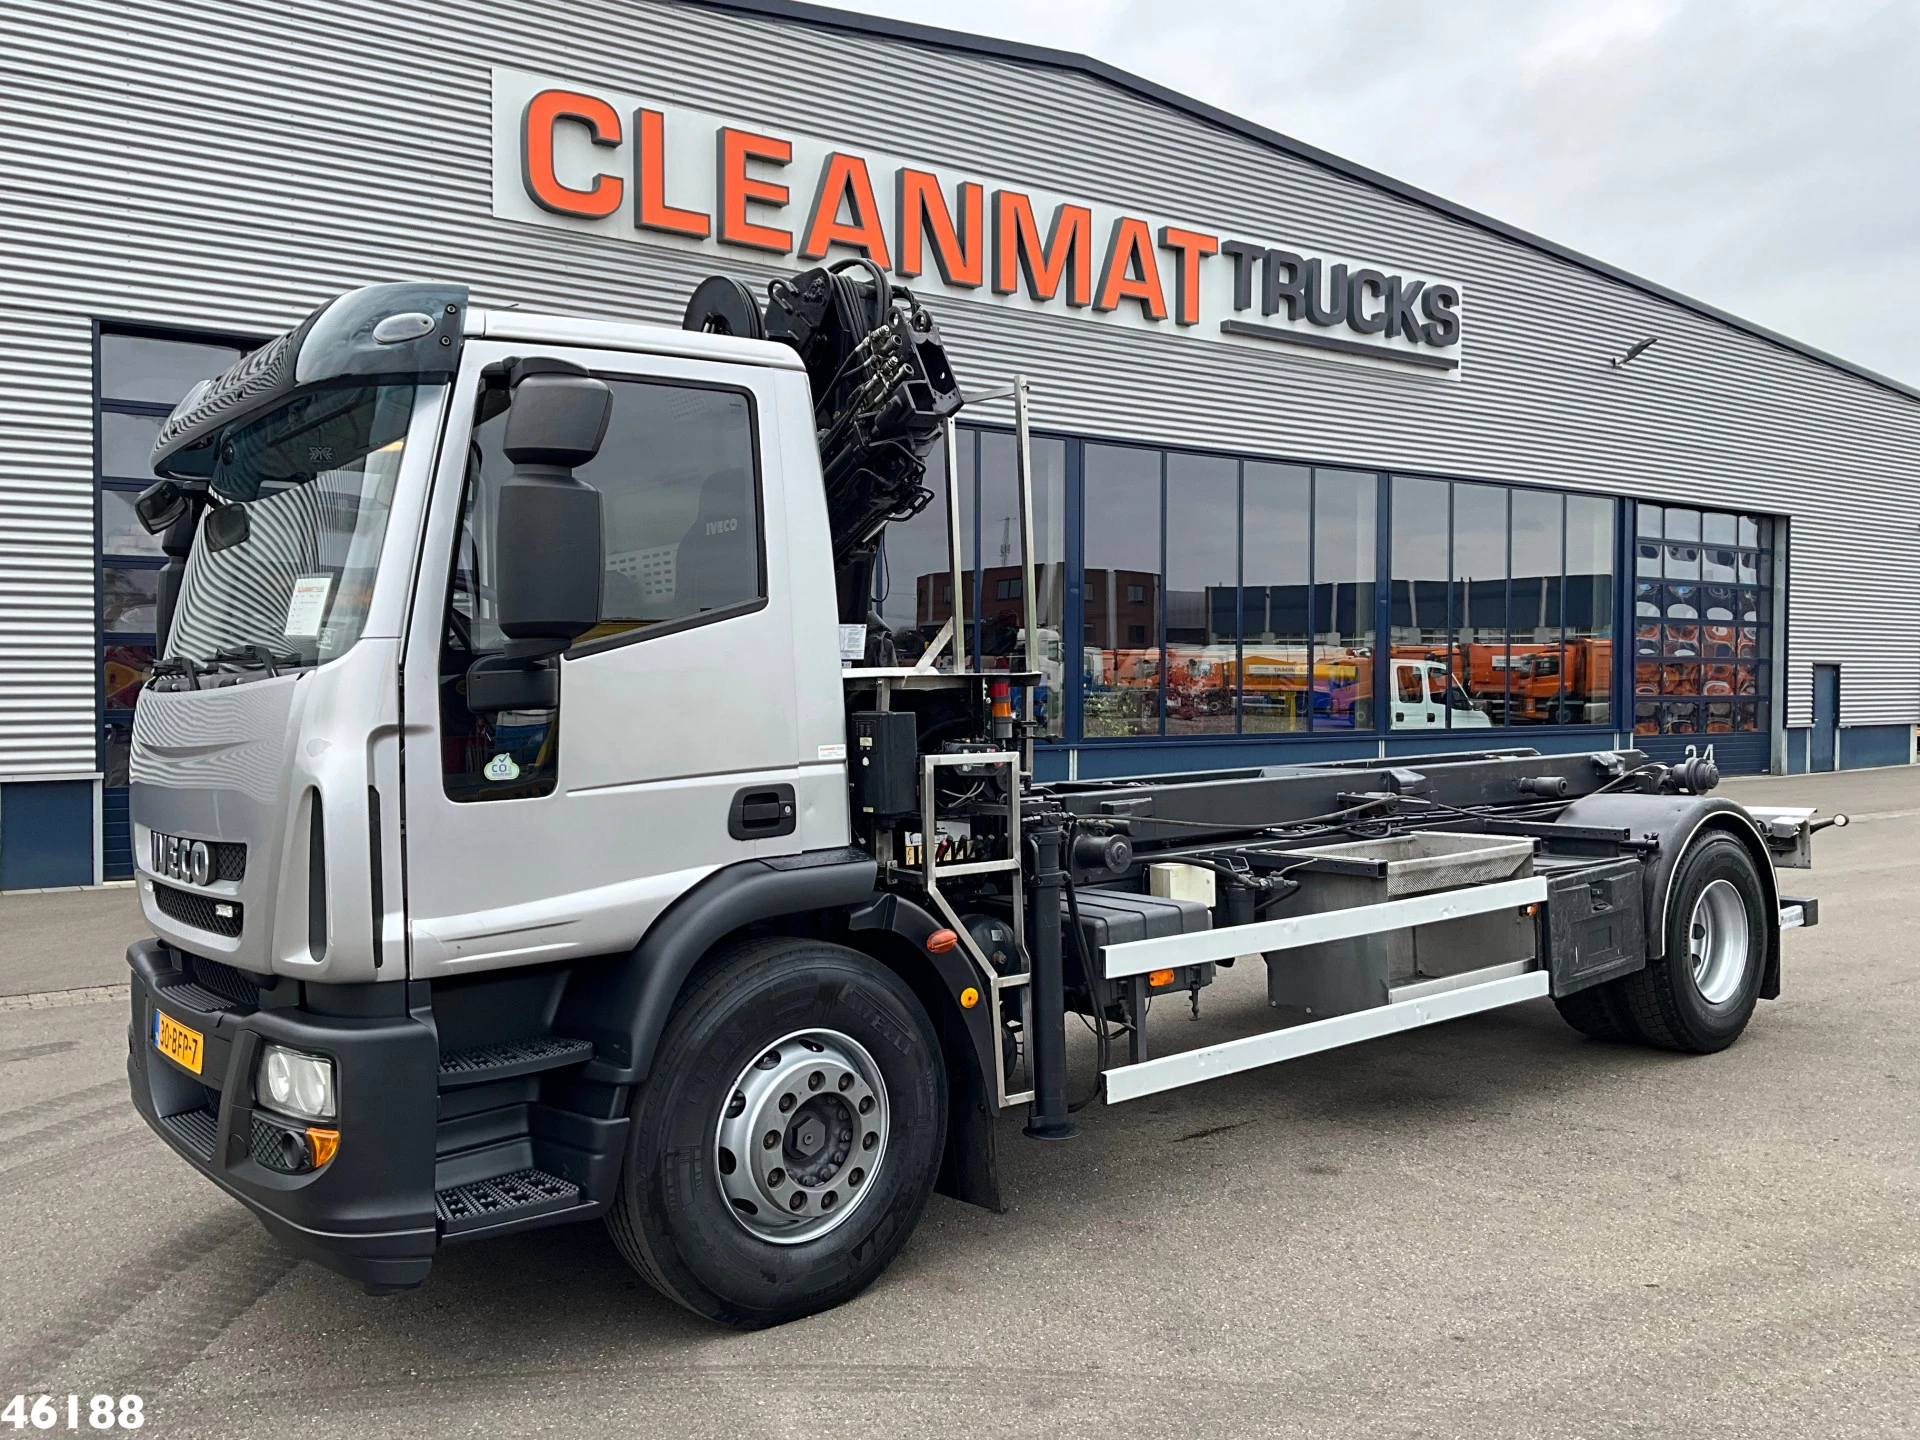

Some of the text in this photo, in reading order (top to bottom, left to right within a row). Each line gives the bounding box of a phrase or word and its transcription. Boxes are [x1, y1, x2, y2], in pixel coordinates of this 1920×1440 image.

[520, 89, 1460, 347] CLEANMAT TRUCKS
[705, 518, 738, 536] IVECO
[151, 831, 213, 886] IVECO
[160, 1020, 198, 1065] 30-BFP-7
